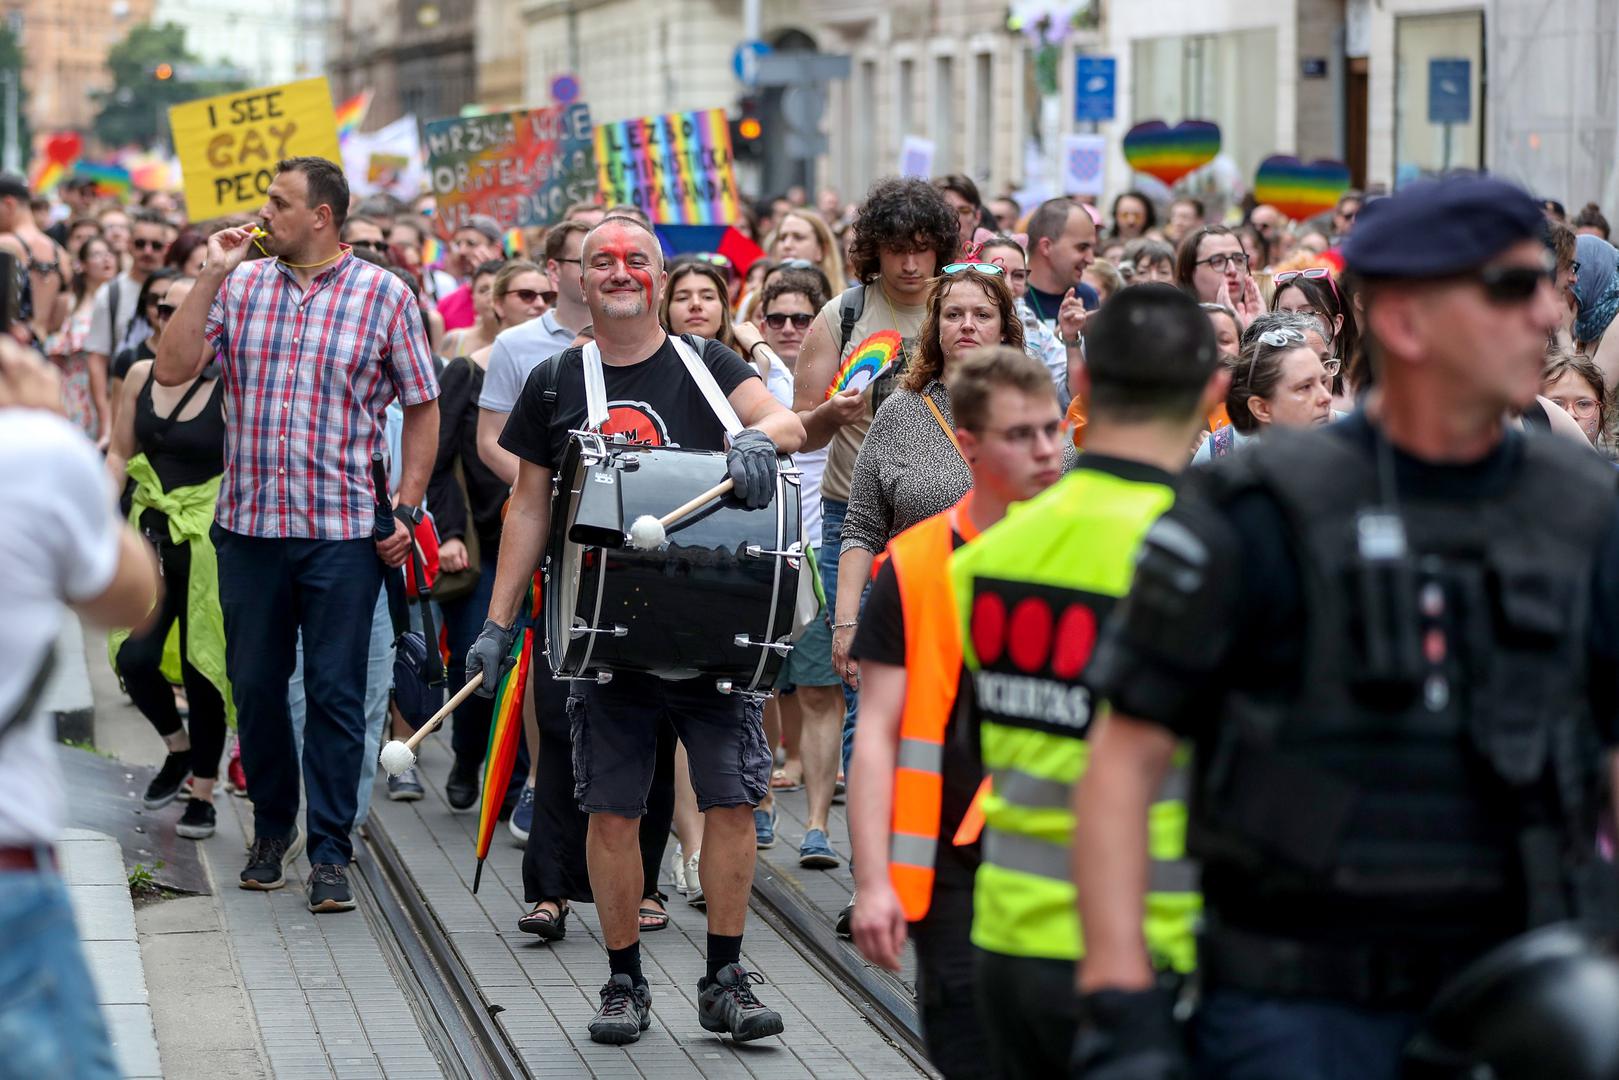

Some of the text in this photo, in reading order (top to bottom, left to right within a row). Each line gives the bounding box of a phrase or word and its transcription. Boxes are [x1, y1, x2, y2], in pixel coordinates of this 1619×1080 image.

[208, 91, 284, 128] I SEE
[206, 121, 297, 169] GAY
